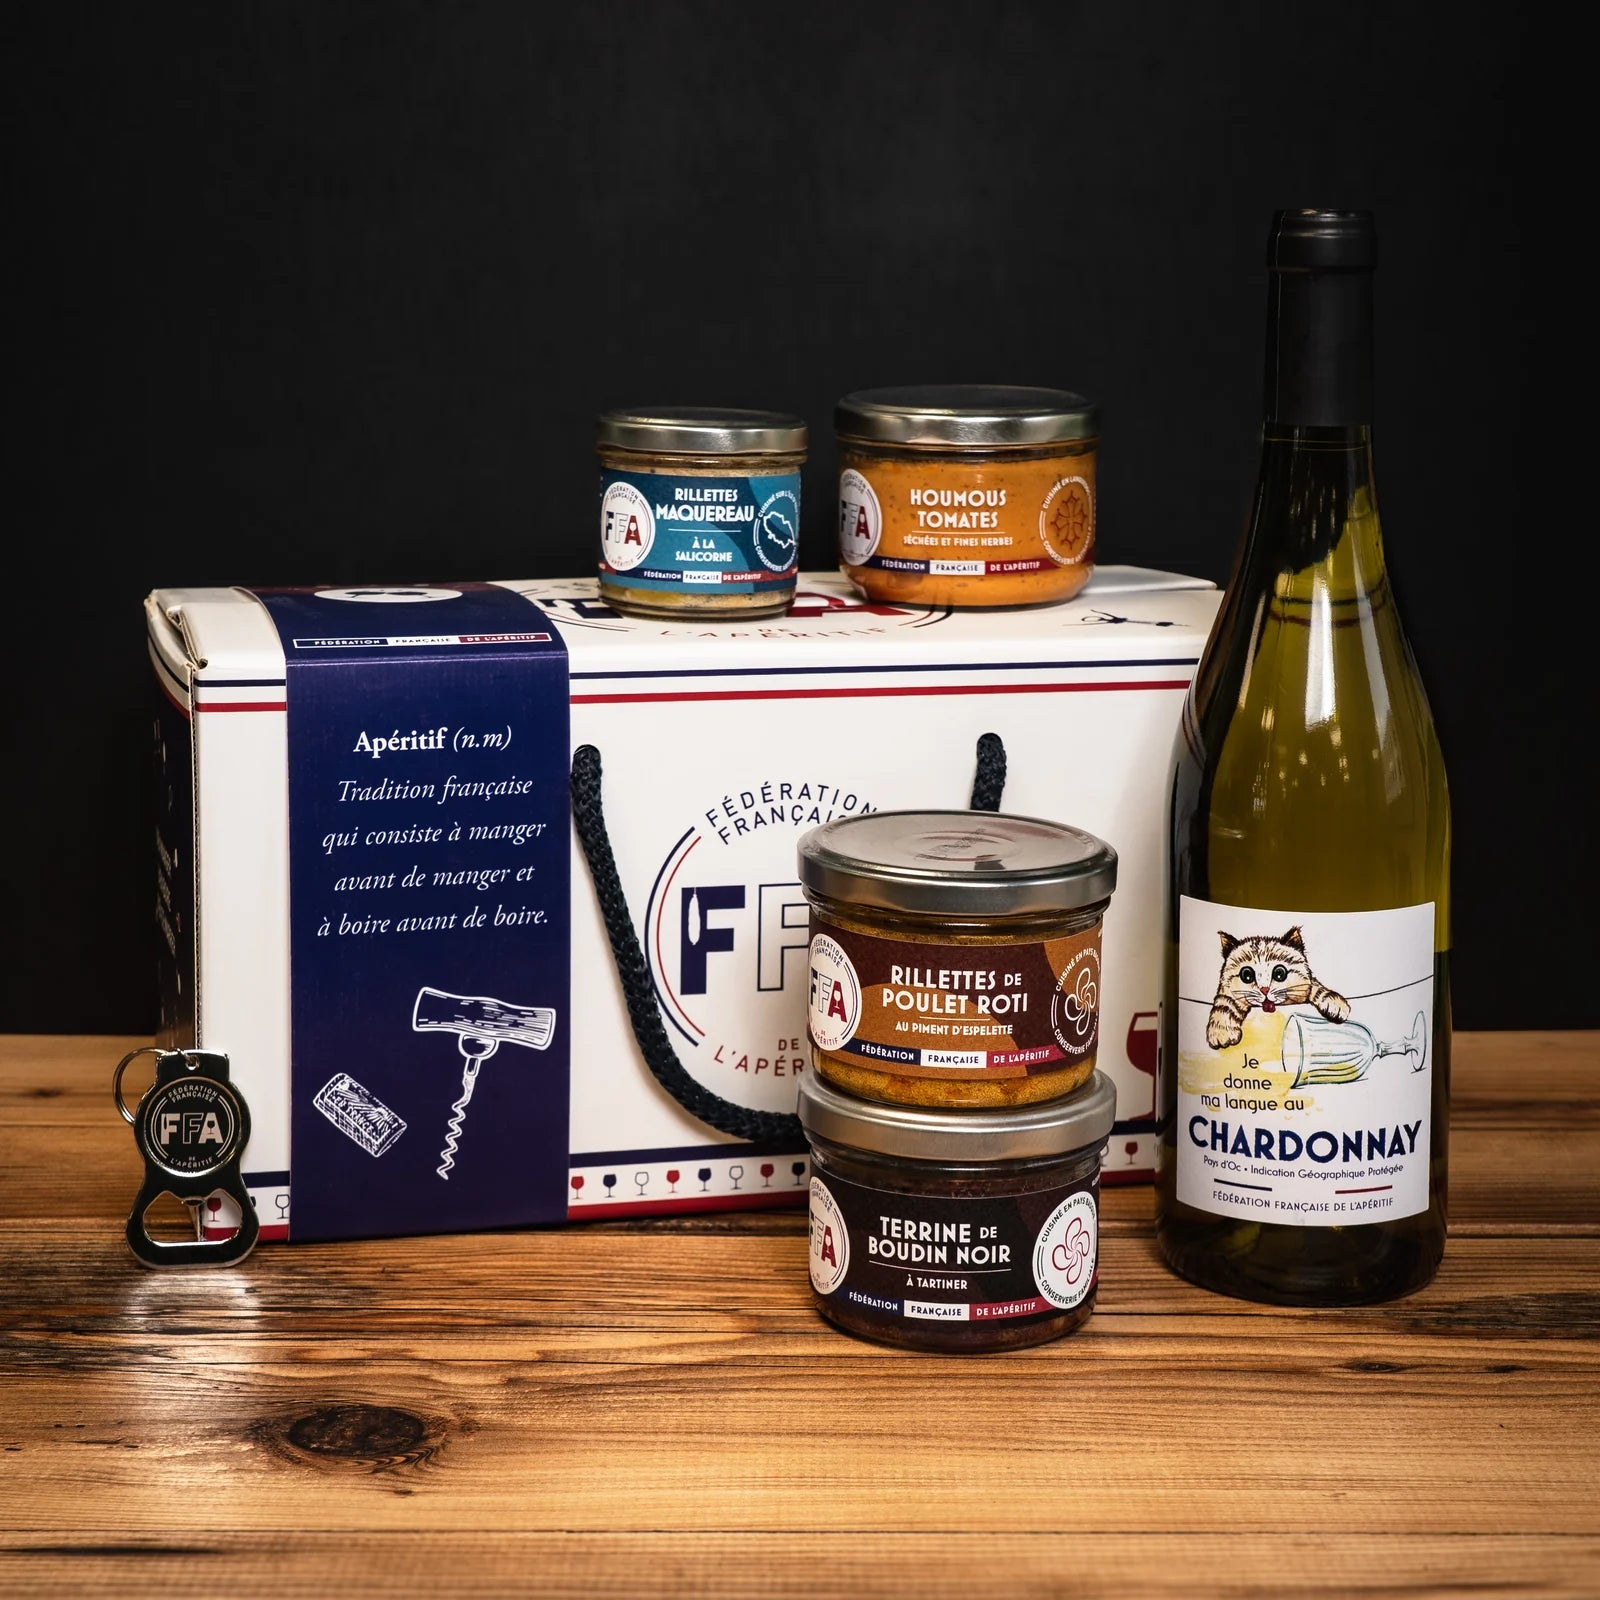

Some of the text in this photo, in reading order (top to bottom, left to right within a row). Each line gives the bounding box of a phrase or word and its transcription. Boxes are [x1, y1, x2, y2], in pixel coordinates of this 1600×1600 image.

[674, 487, 739, 502] RILLETTES
[910, 488, 1007, 507] HOUMOUS
[656, 504, 755, 522] MAQUEREAU
[917, 511, 999, 529] TOMATES
[605, 510, 642, 546] FFA
[903, 534, 1014, 547] SÉCHÉES ET FINES HERBES
[692, 536, 715, 549] À LA
[675, 550, 733, 562] SALICORNE
[881, 559, 1041, 572] FÉDÉRATION FRANÇAISE DE L'APÉRITIF
[643, 570, 682, 580] FÉDÉRATION
[685, 573, 720, 582] FRANÇAISE
[733, 572, 762, 581] L'APÉRITIF
[314, 638, 381, 647] FÉDÉRATION
[395, 637, 452, 645] FRANÇAISE
[484, 634, 537, 643] L'APÉRITIF
[352, 725, 513, 759] Apéritif (n.m)
[337, 775, 534, 805] Tradition française
[718, 804, 848, 845] FRANÇAI
[322, 821, 547, 855] qui consiste à manger
[334, 865, 536, 892] avant de manger et
[316, 904, 550, 937] à boire avant de boire.
[891, 964, 1022, 991] RILLETTES DE
[1055, 957, 1076, 992] CUISINÉ
[1075, 950, 1083, 964] EN
[810, 966, 848, 1023] FFA
[881, 987, 1029, 1015] POULET ROTI
[895, 1020, 1013, 1036] AU PIMENT D'ESPELETTE
[777, 1038, 800, 1051] DE
[860, 1043, 1050, 1066] FÉDÉRATION FRANÇAISE DE L'APÉRITIF
[1053, 1028, 1086, 1055] CONSERVERIE
[713, 1045, 806, 1077] L'APÉR
[1241, 1052, 1260, 1070] Je
[168, 1084, 218, 1098] FÉDÉRATION
[1223, 1073, 1273, 1091] donne
[171, 1090, 216, 1103] FRANÇAISE
[1200, 1093, 1305, 1115] ma langue au
[161, 1111, 224, 1145] FFA
[1188, 1114, 1423, 1164] CHARDONNAY
[1203, 1154, 1404, 1182] Pays d'Oc Indication Géographique Protégée
[1212, 1189, 1394, 1213] FÉDÉRATION FRANÇAISE DE L'APÉRITIF
[879, 1214, 998, 1244] TERRINE DE
[1041, 1208, 1064, 1243] CUISINÉ
[1063, 1202, 1073, 1214] EN
[1072, 1196, 1086, 1208] PAYS
[867, 1235, 1012, 1265] BOUDIN NOIR
[906, 1273, 968, 1290] À TARTINER
[1041, 1279, 1078, 1305] CONSERVERIE
[849, 1291, 1037, 1319] FÉDÉRATION FRANÇAISE DE L'APÉRITIF
